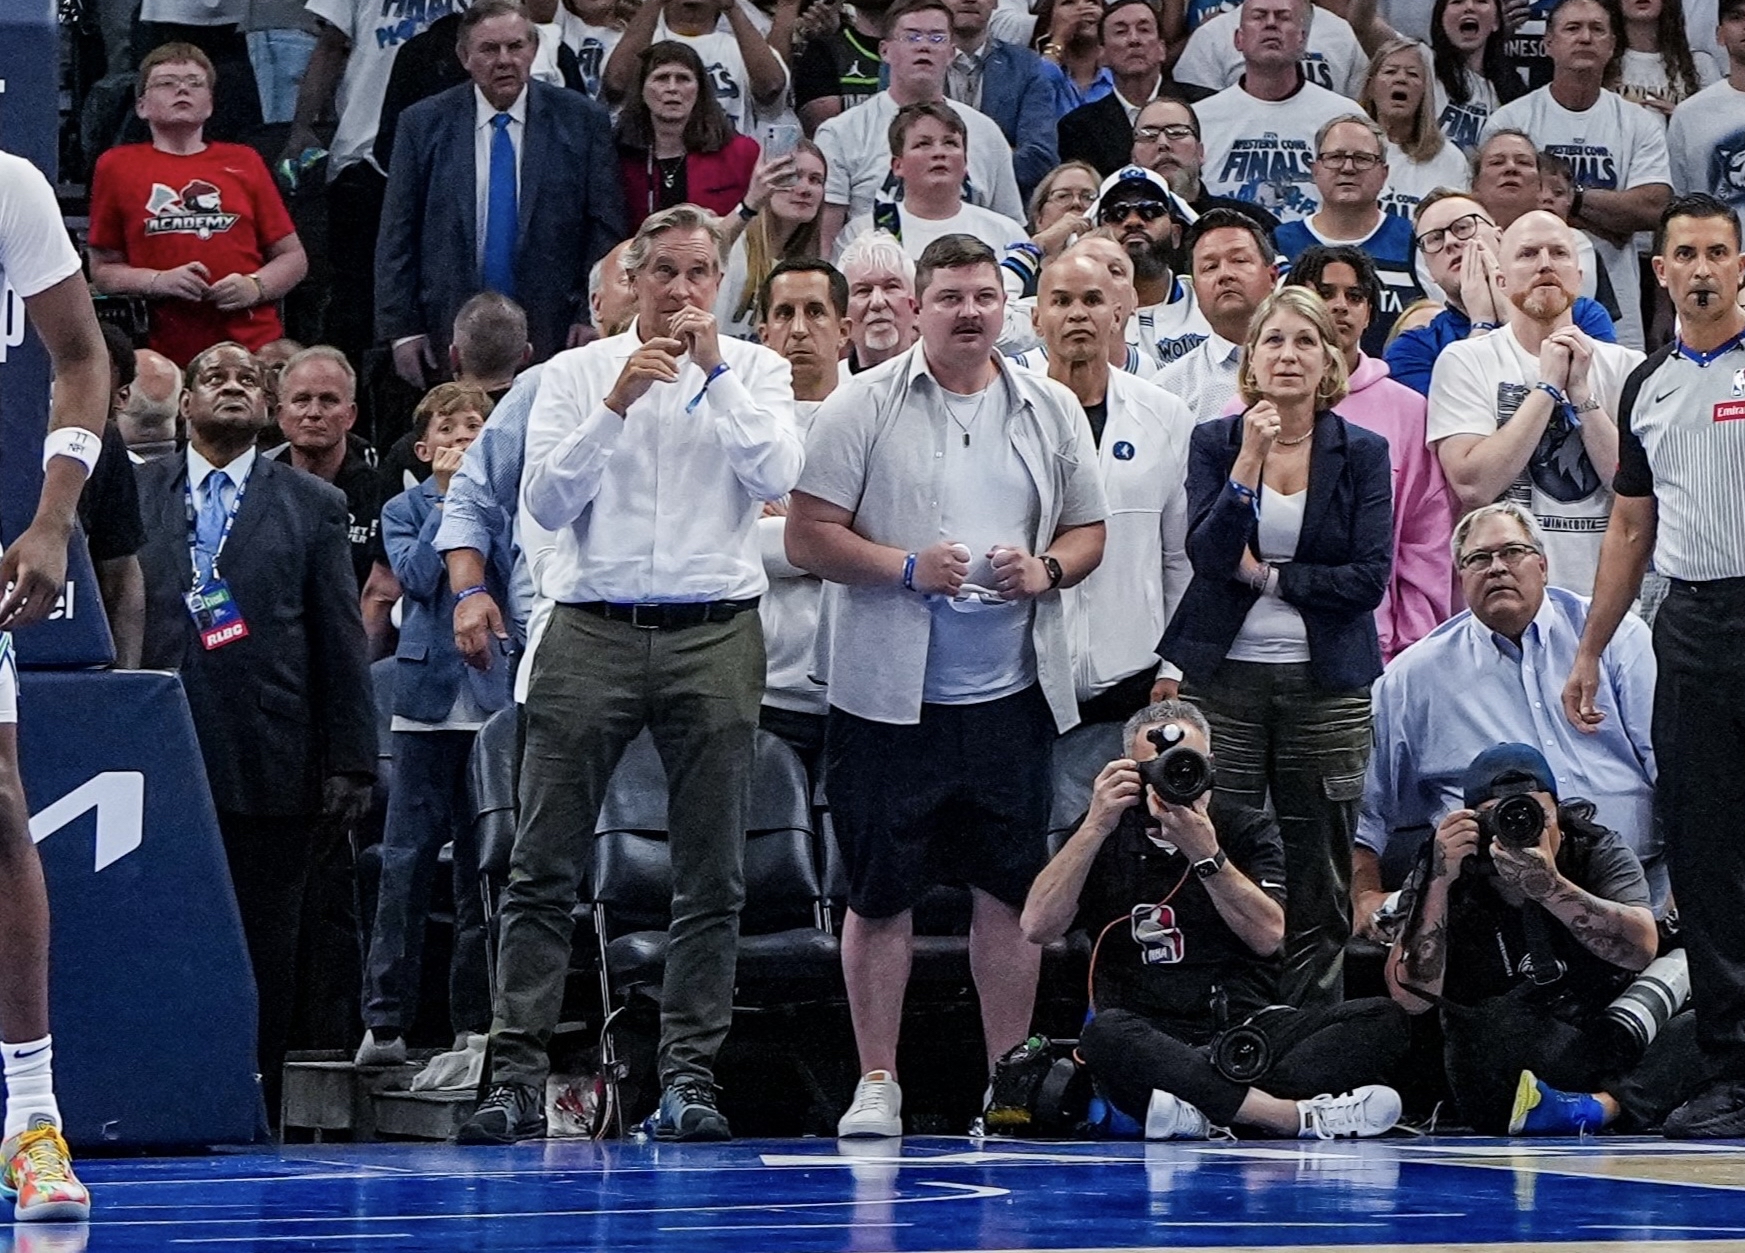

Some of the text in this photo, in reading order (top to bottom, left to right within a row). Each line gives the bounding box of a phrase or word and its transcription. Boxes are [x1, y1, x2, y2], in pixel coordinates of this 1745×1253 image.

[1218, 150, 1316, 183] FINALS
[148, 214, 241, 237] ACADEMY
[1543, 517, 1597, 531] MINNESOTA
[206, 622, 244, 648] RLBC
